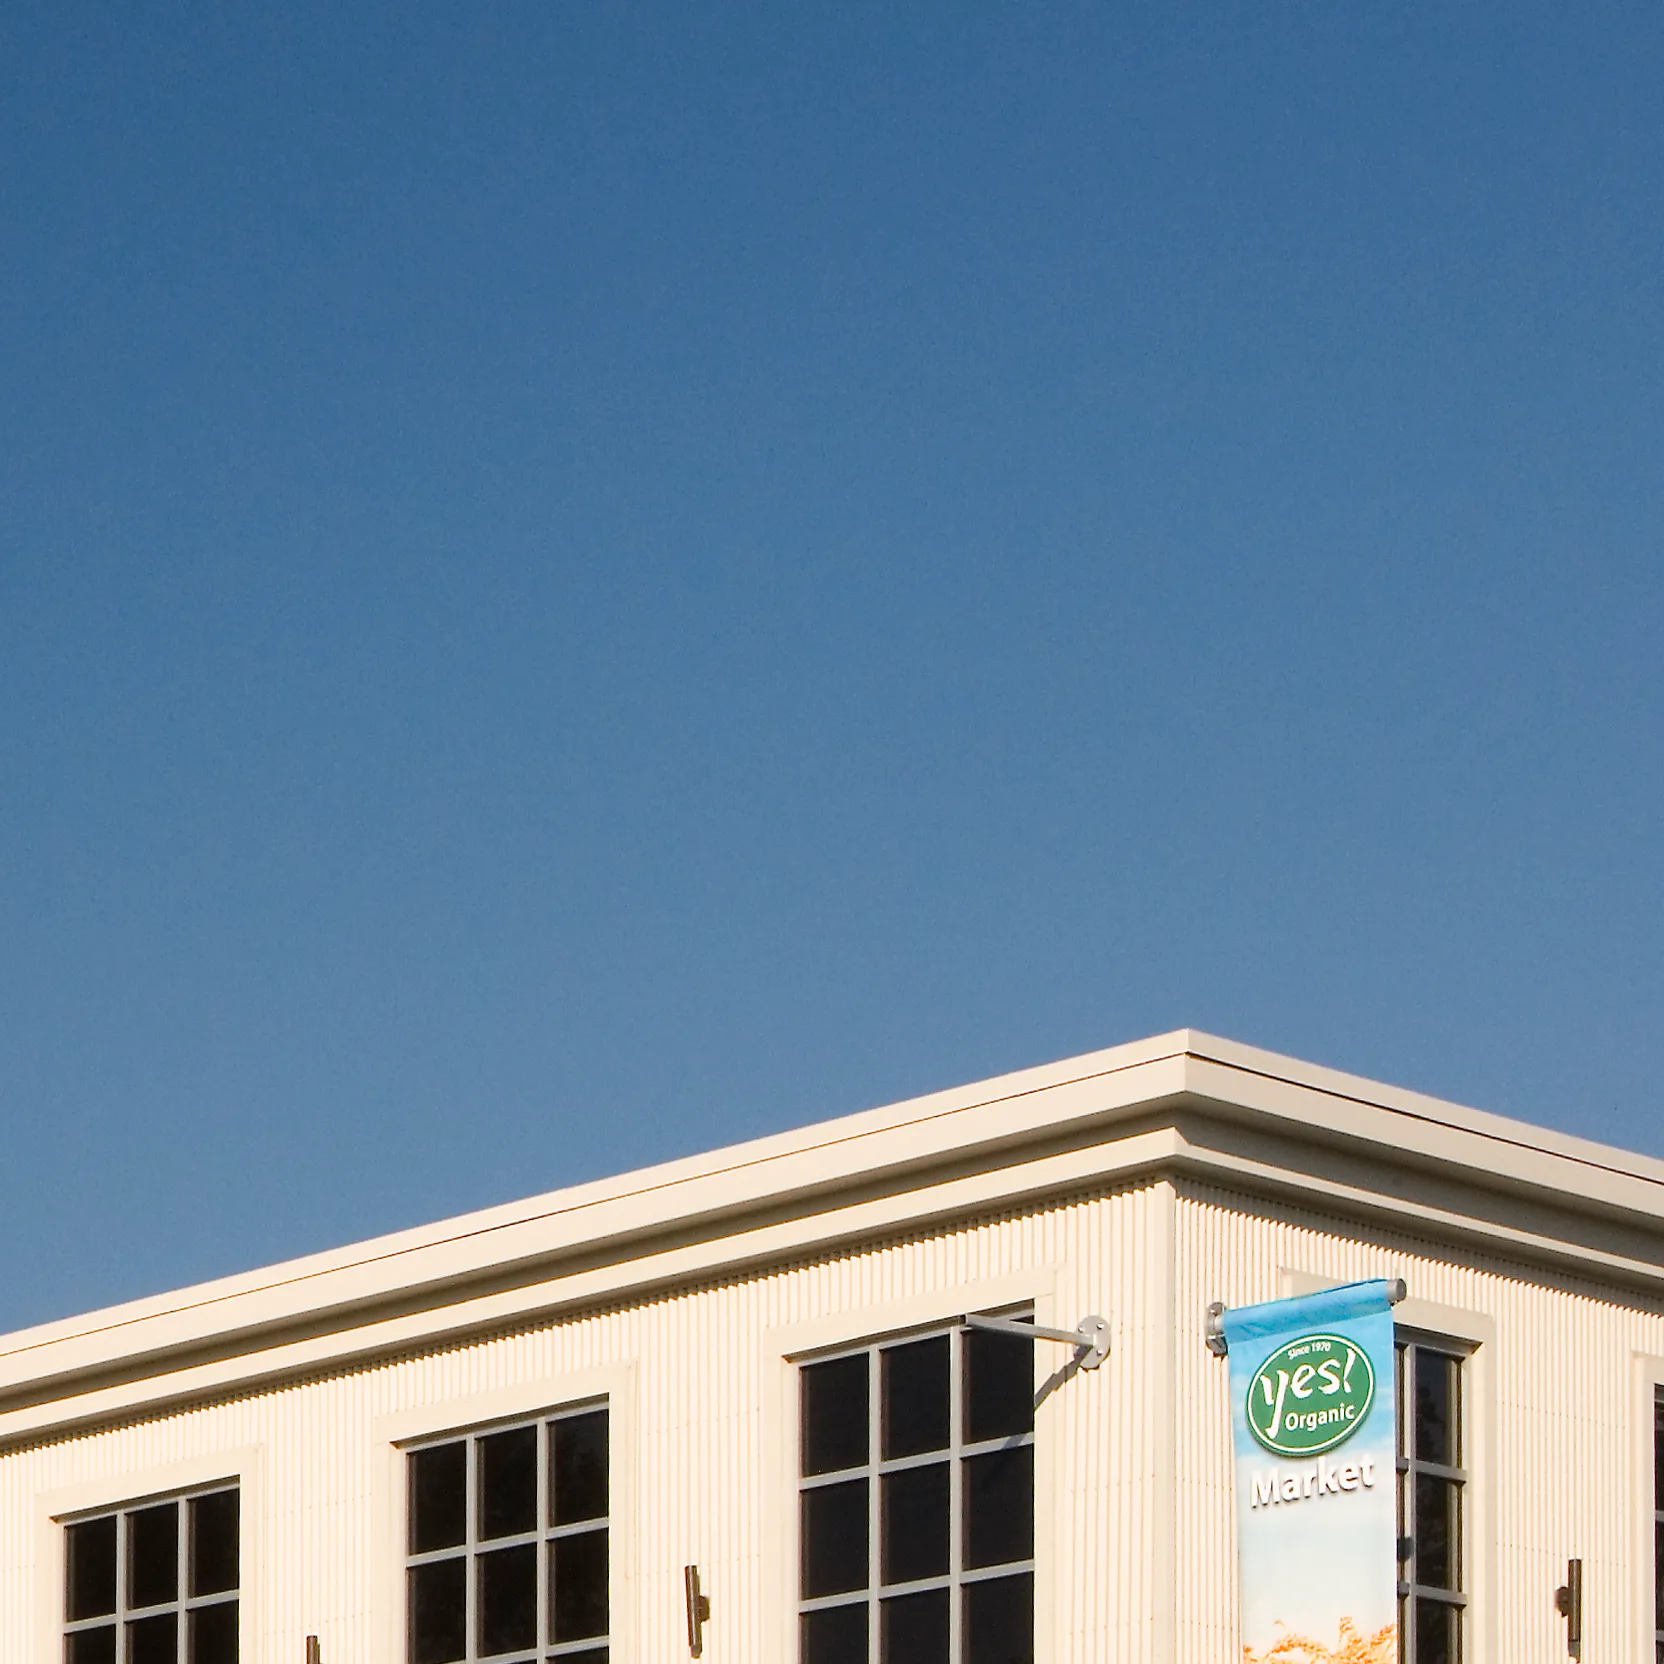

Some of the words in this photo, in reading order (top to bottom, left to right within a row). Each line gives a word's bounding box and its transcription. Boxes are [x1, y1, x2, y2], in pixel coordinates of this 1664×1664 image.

[1288, 1344, 1310, 1360] Since
[1311, 1341, 1332, 1353] 1970
[1259, 1348, 1357, 1440] yes!
[1285, 1403, 1355, 1432] Organic
[1250, 1454, 1375, 1508] Market
